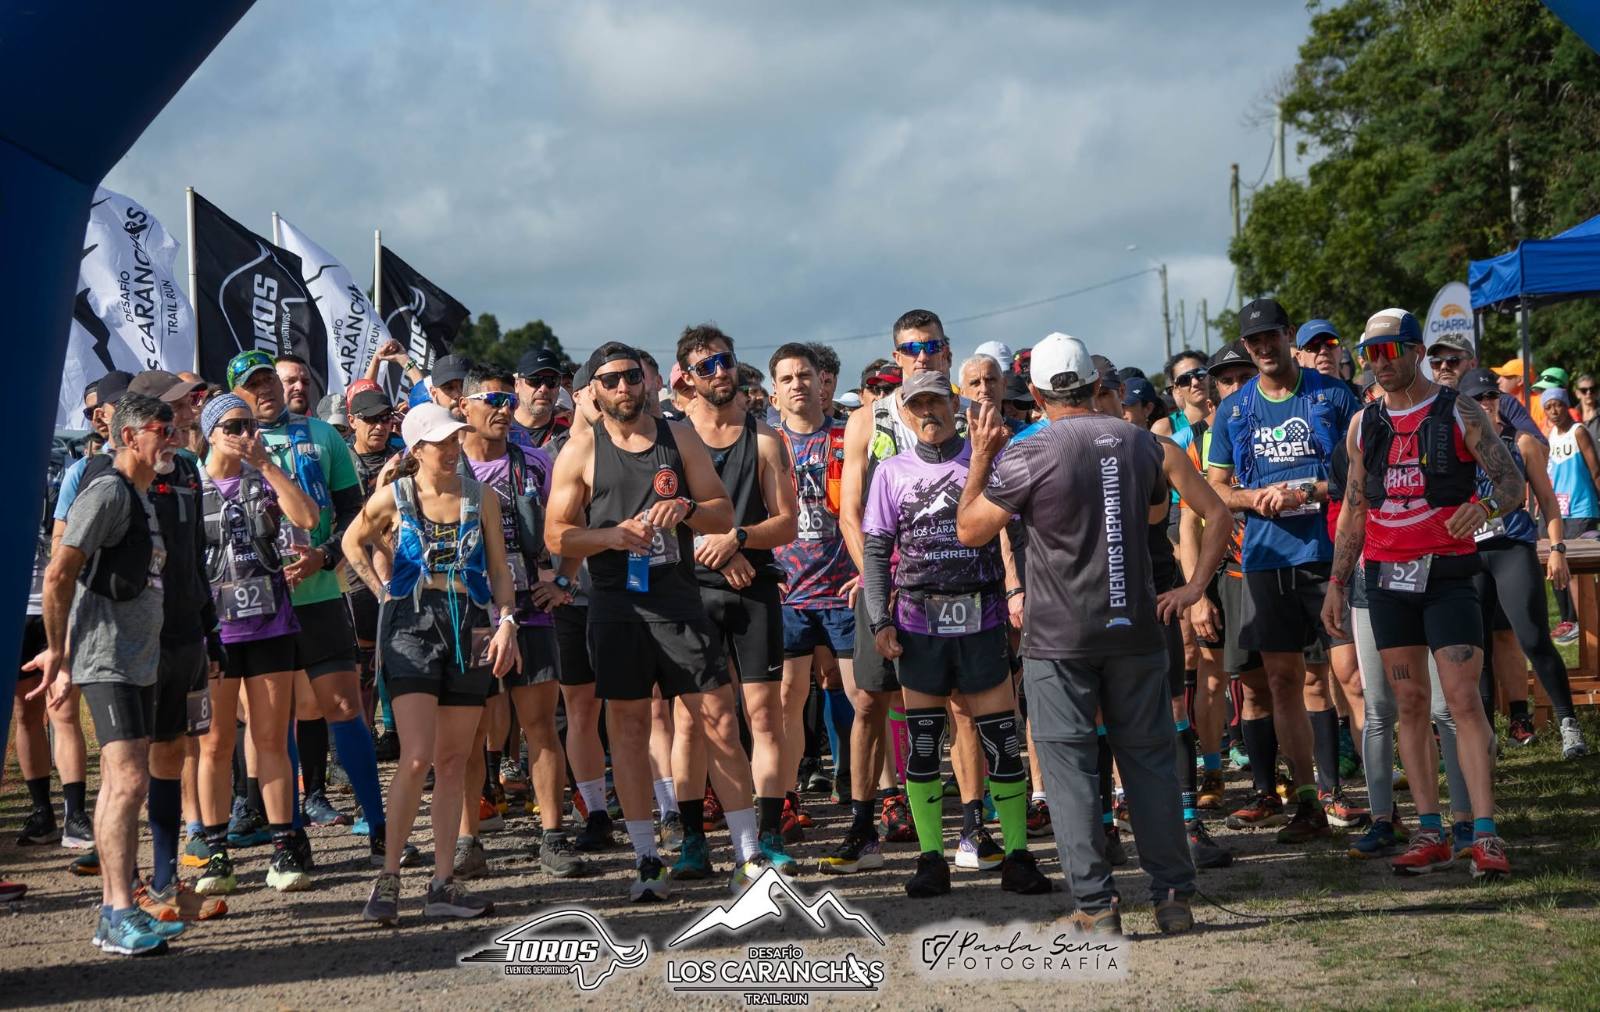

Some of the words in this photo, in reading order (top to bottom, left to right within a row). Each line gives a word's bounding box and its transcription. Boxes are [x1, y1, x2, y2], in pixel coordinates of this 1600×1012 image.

[161, 279, 178, 300] RUN
[167, 301, 179, 336] TRAIL
[252, 273, 278, 358] OROS
[1254, 441, 1316, 458] PADEL
[1436, 423, 1448, 473] KIPRUN
[1100, 456, 1122, 542] DEPORTIVOS
[913, 526, 928, 537] LOS
[924, 549, 980, 560] MERRELL
[1108, 545, 1127, 608] EVENTOS
[1392, 561, 1418, 582] 52
[234, 585, 262, 608] 92
[938, 602, 966, 625] 40
